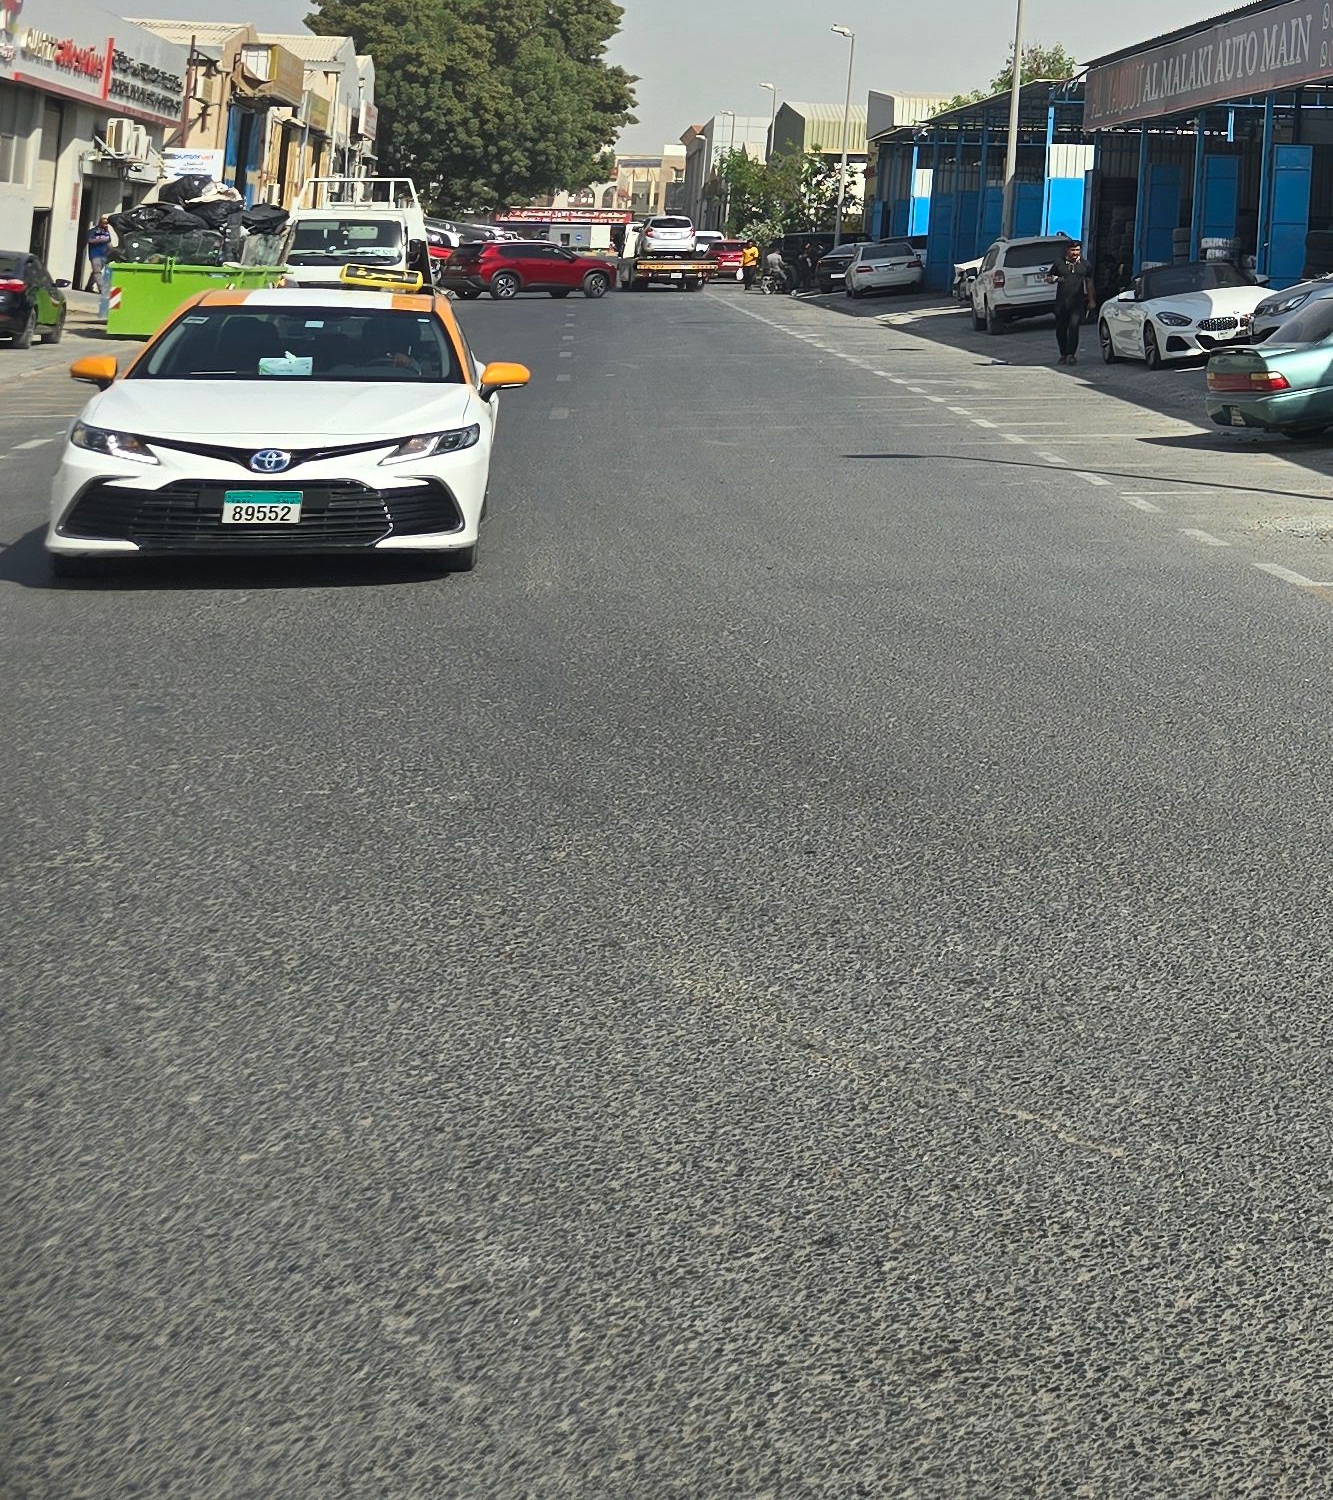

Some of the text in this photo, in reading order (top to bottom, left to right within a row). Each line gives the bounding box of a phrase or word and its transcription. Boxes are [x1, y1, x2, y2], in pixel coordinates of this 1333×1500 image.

[1142, 62, 1158, 103] AL
[1159, 44, 1214, 98] MALAKI
[1213, 30, 1259, 84] AUTO
[1260, 13, 1313, 73] MAIN
[232, 506, 291, 521] 89552
